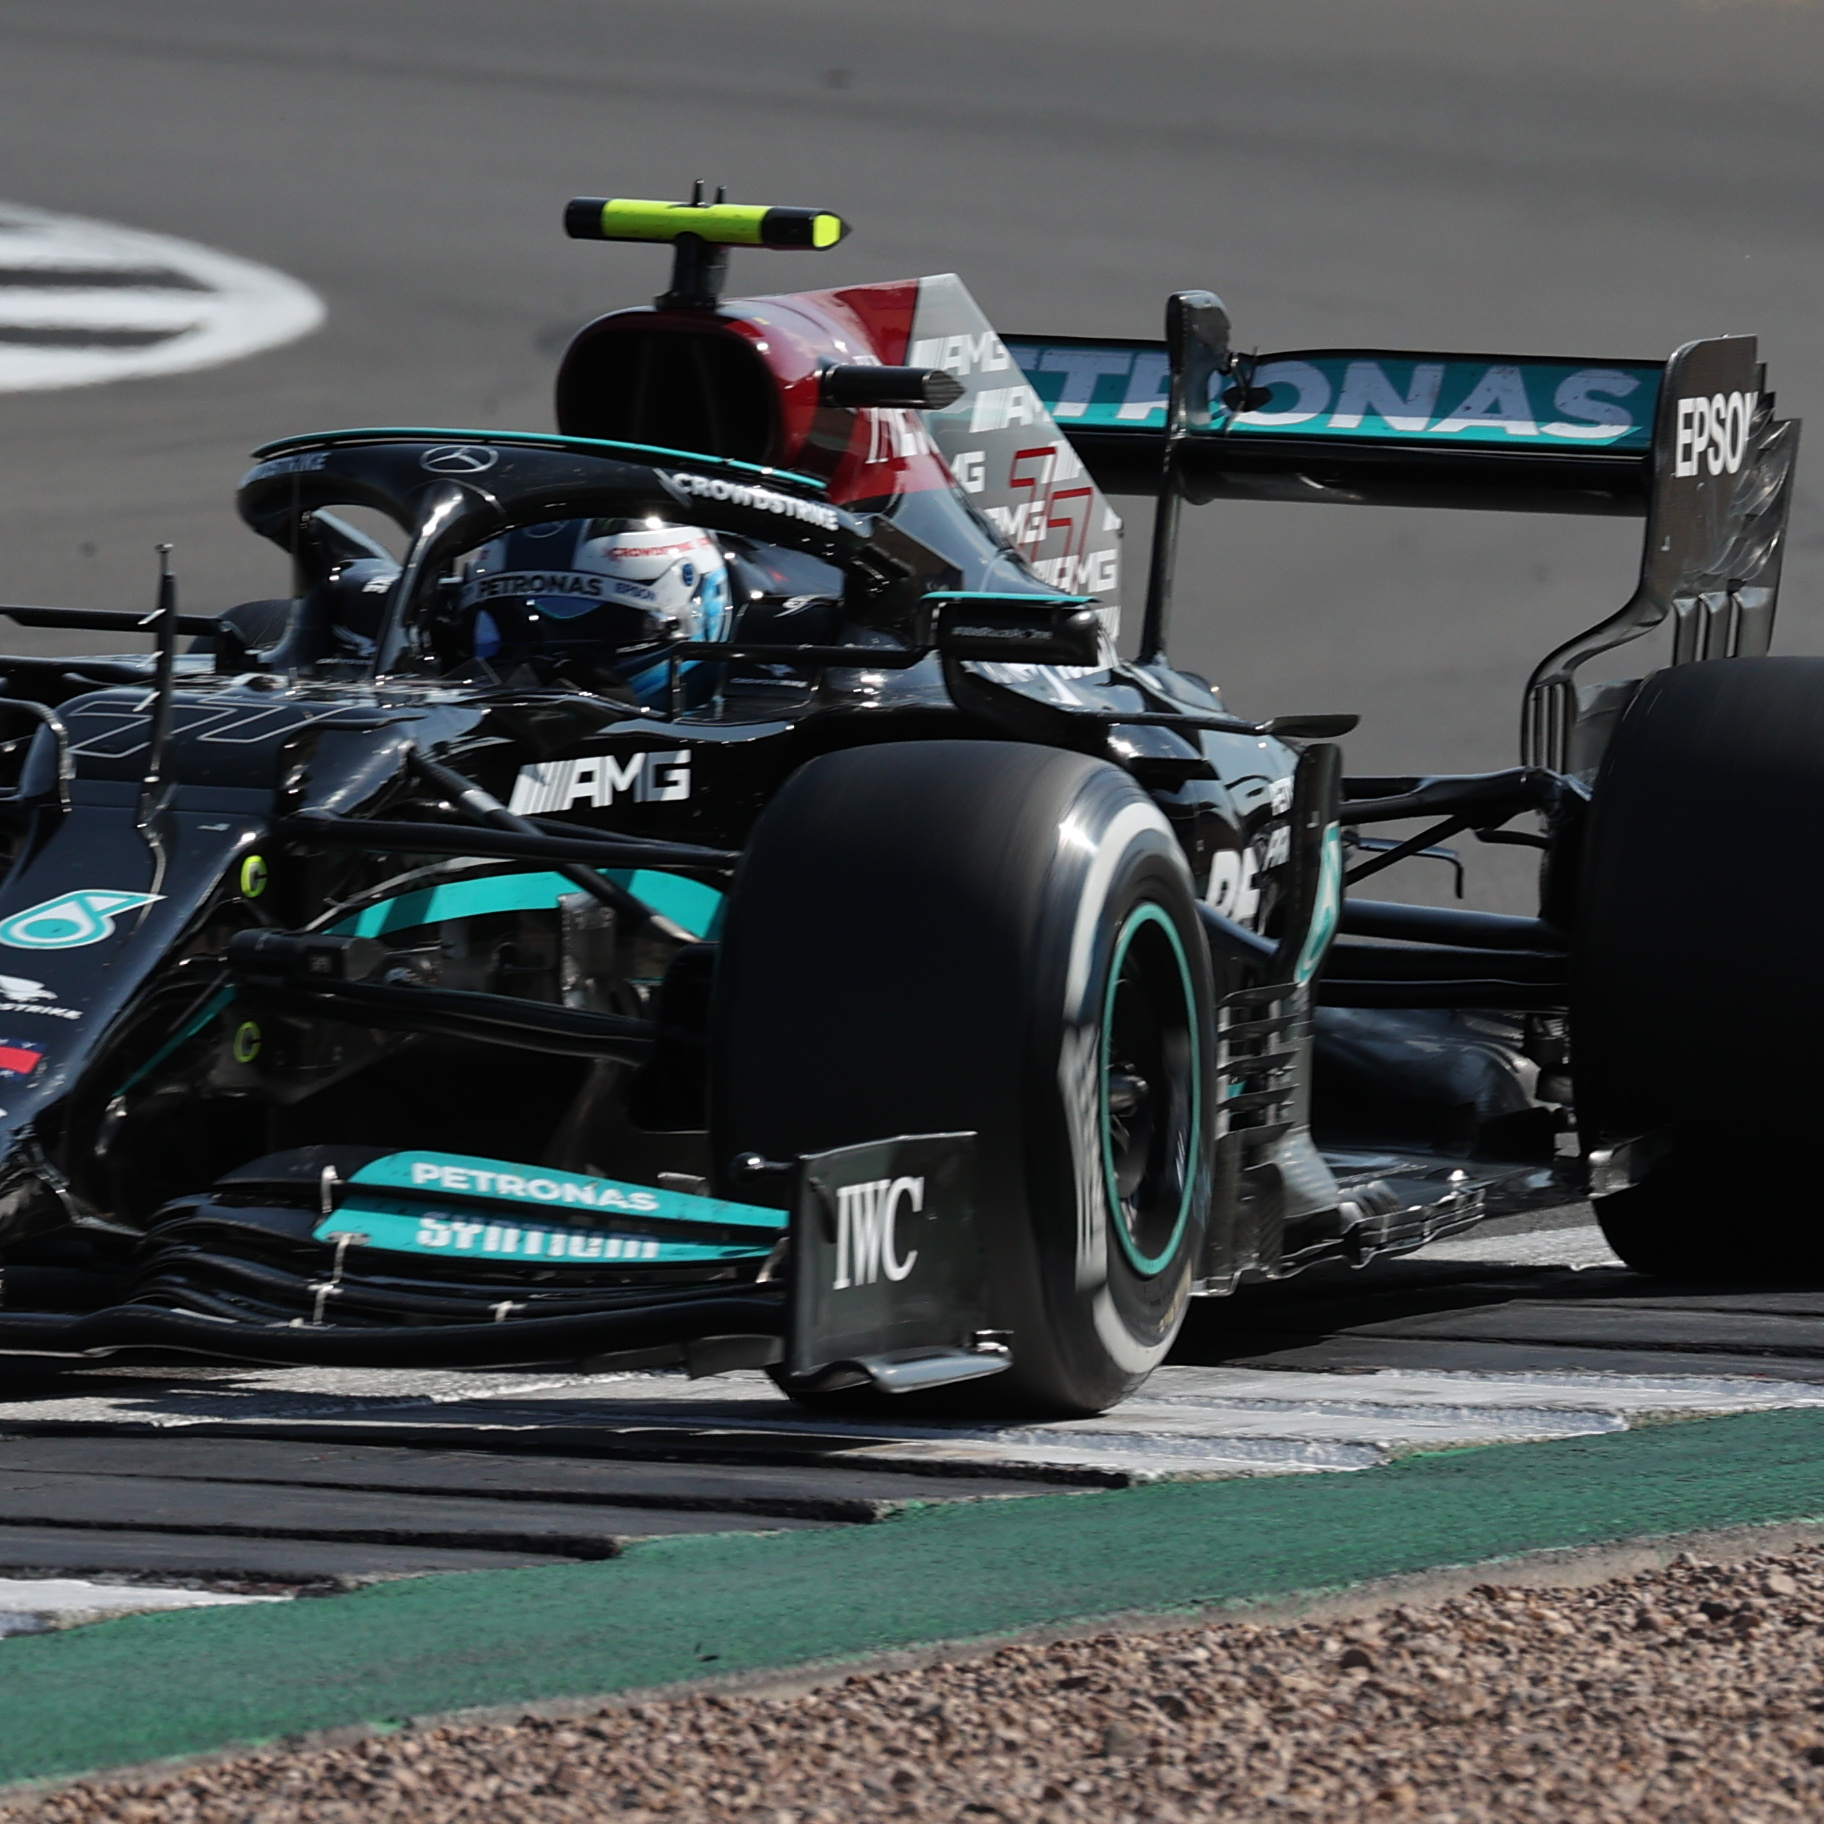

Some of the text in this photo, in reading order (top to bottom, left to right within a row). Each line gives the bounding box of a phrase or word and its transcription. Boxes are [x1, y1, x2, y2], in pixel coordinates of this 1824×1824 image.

[1005, 346, 1632, 442] TRONAS
[670, 472, 839, 531] CROWDSTRIKE
[480, 574, 603, 597] PETRONAS
[564, 749, 692, 809] AMG
[410, 1162, 660, 1211] PETRONAS
[832, 1176, 926, 1291] IWC
